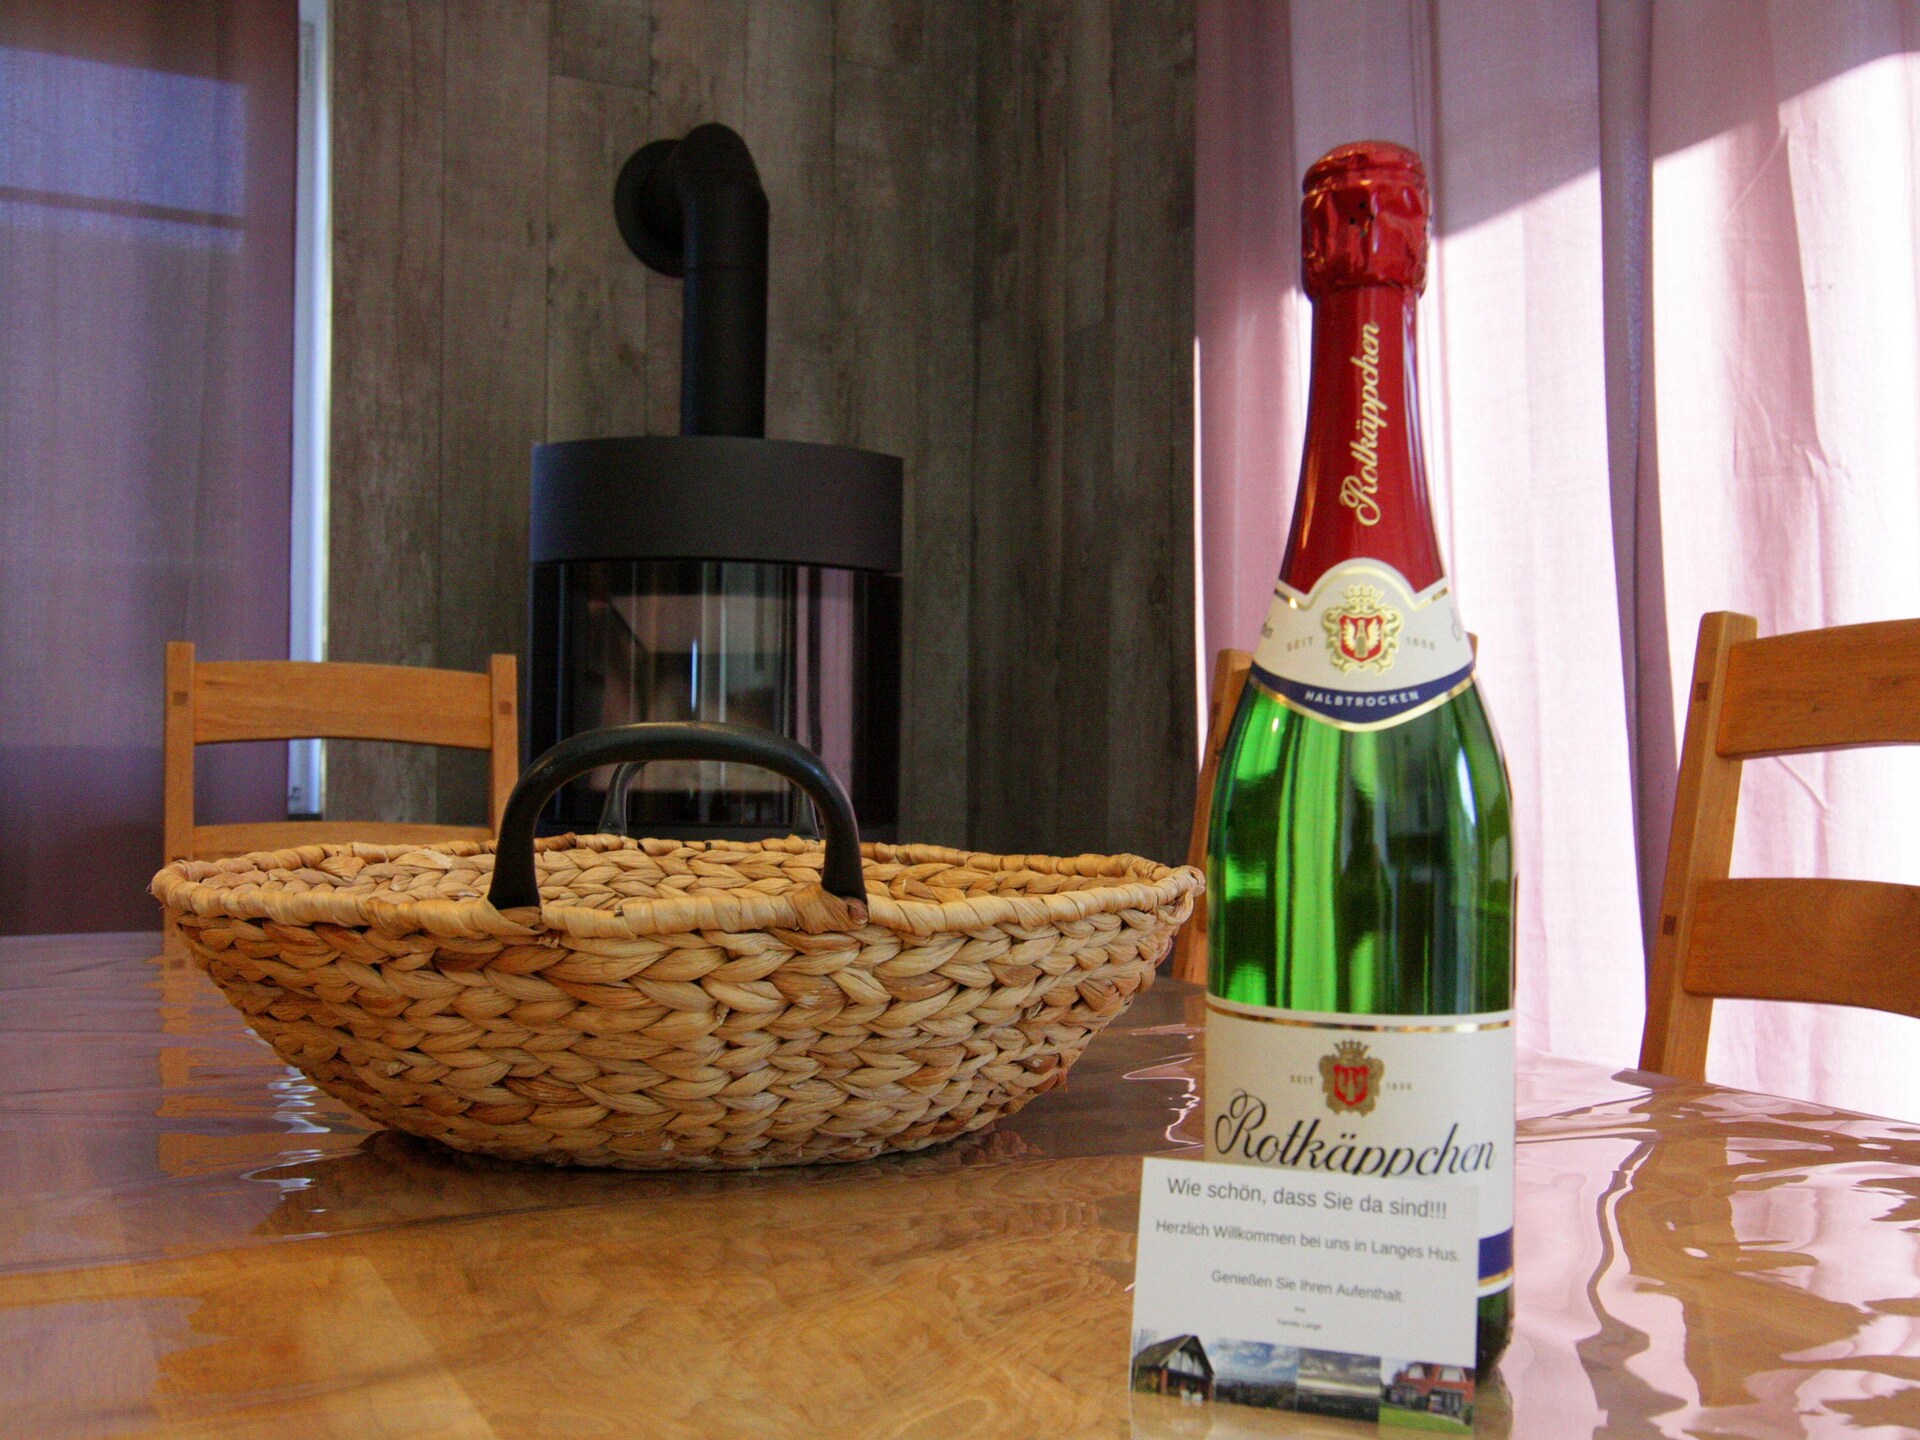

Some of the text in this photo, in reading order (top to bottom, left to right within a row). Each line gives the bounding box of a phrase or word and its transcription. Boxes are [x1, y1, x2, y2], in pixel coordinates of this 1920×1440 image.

[1340, 320, 1388, 526] Rotkäppchen
[1287, 636, 1314, 652] SEIT
[1305, 690, 1420, 707] HALBTROCKEN
[1215, 1089, 1494, 1178] Rotkäppchen
[1167, 1177, 1448, 1219] Wie schön, dass Sie da sind!!!
[1156, 1219, 1461, 1262] Herzlich Willkommen bei uns in Langes Hus.
[1211, 1270, 1272, 1289] Genießen
[1276, 1276, 1297, 1291] Sie
[1301, 1279, 1333, 1295] Ihren
